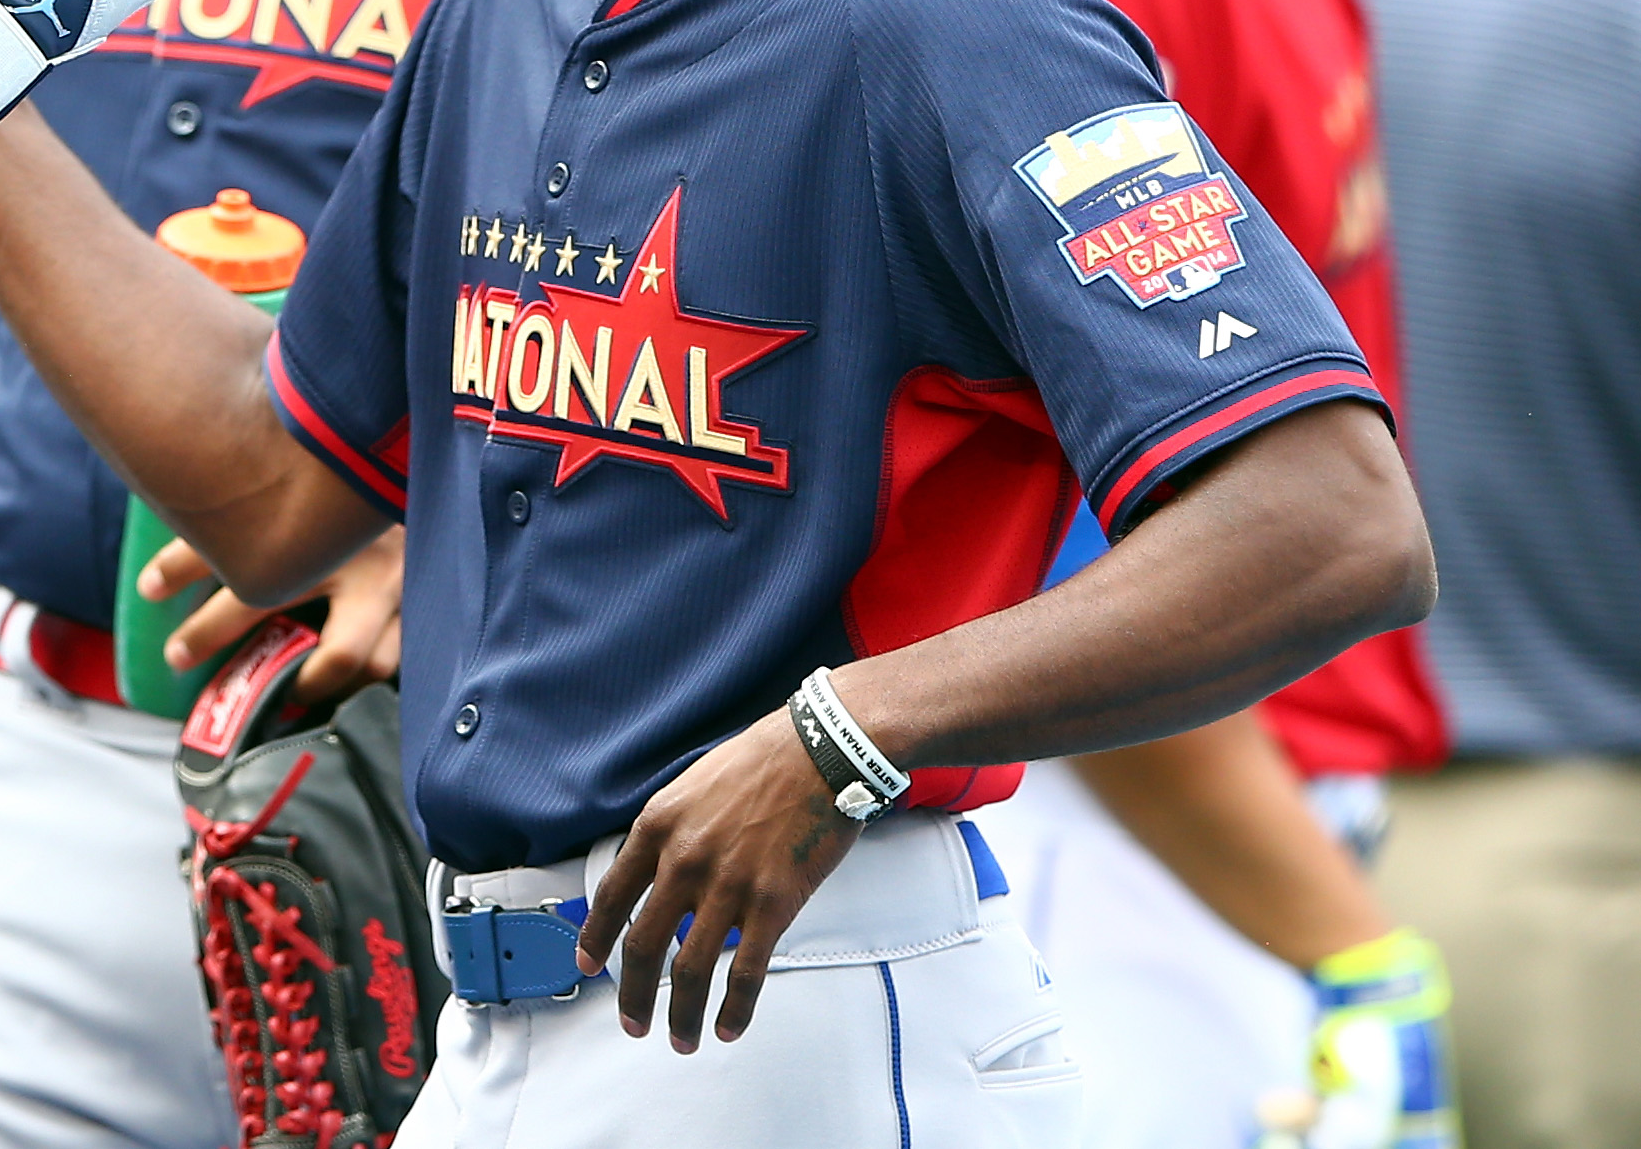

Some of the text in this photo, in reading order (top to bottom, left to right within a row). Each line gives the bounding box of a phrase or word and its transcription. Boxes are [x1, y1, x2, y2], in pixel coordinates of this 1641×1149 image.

[1115, 178, 1164, 210] MLB
[1084, 186, 1232, 269] ALL STAR
[1125, 221, 1220, 277] GAME
[1140, 249, 1228, 294] 20 14
[823, 704, 841, 728] THE
[839, 727, 867, 761] THAN
[866, 758, 900, 791] FASTER
